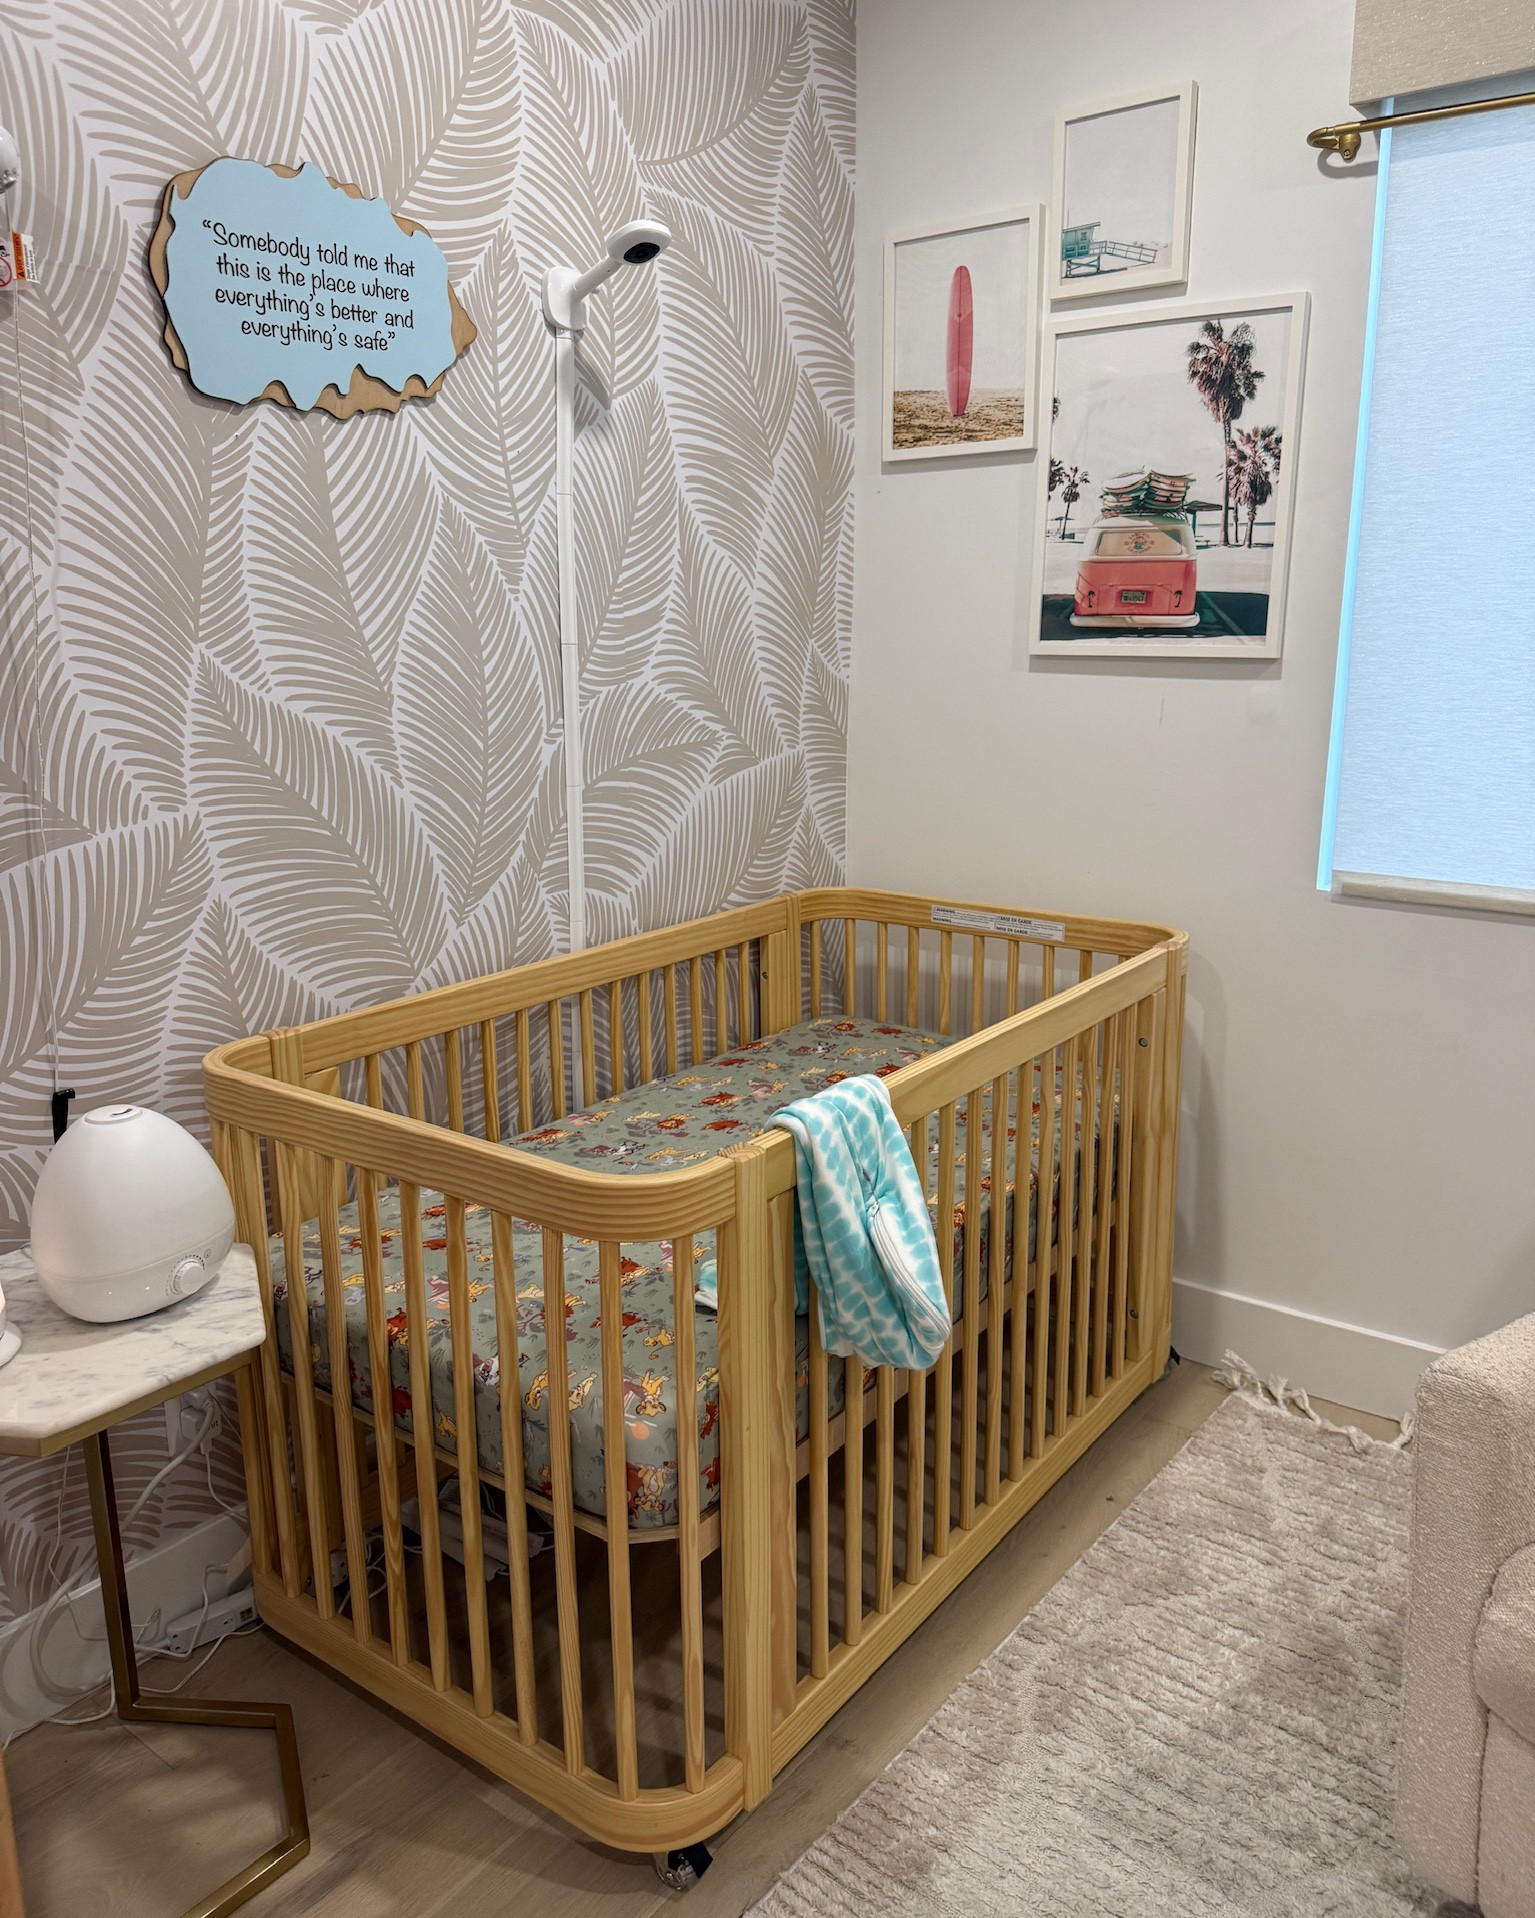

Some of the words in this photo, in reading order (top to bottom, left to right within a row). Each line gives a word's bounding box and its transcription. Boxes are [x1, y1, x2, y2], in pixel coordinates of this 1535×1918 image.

[202, 219, 311, 267] “Somebody
[316, 242, 348, 267] told
[354, 252, 379, 271] me
[384, 252, 416, 278] that
[216, 252, 251, 279] this
[256, 261, 272, 282] is
[277, 263, 306, 287] the
[311, 268, 357, 296] place
[361, 277, 410, 302] where
[330, 297, 379, 324] better
[384, 308, 415, 330] and
[353, 329, 397, 352] safe”
